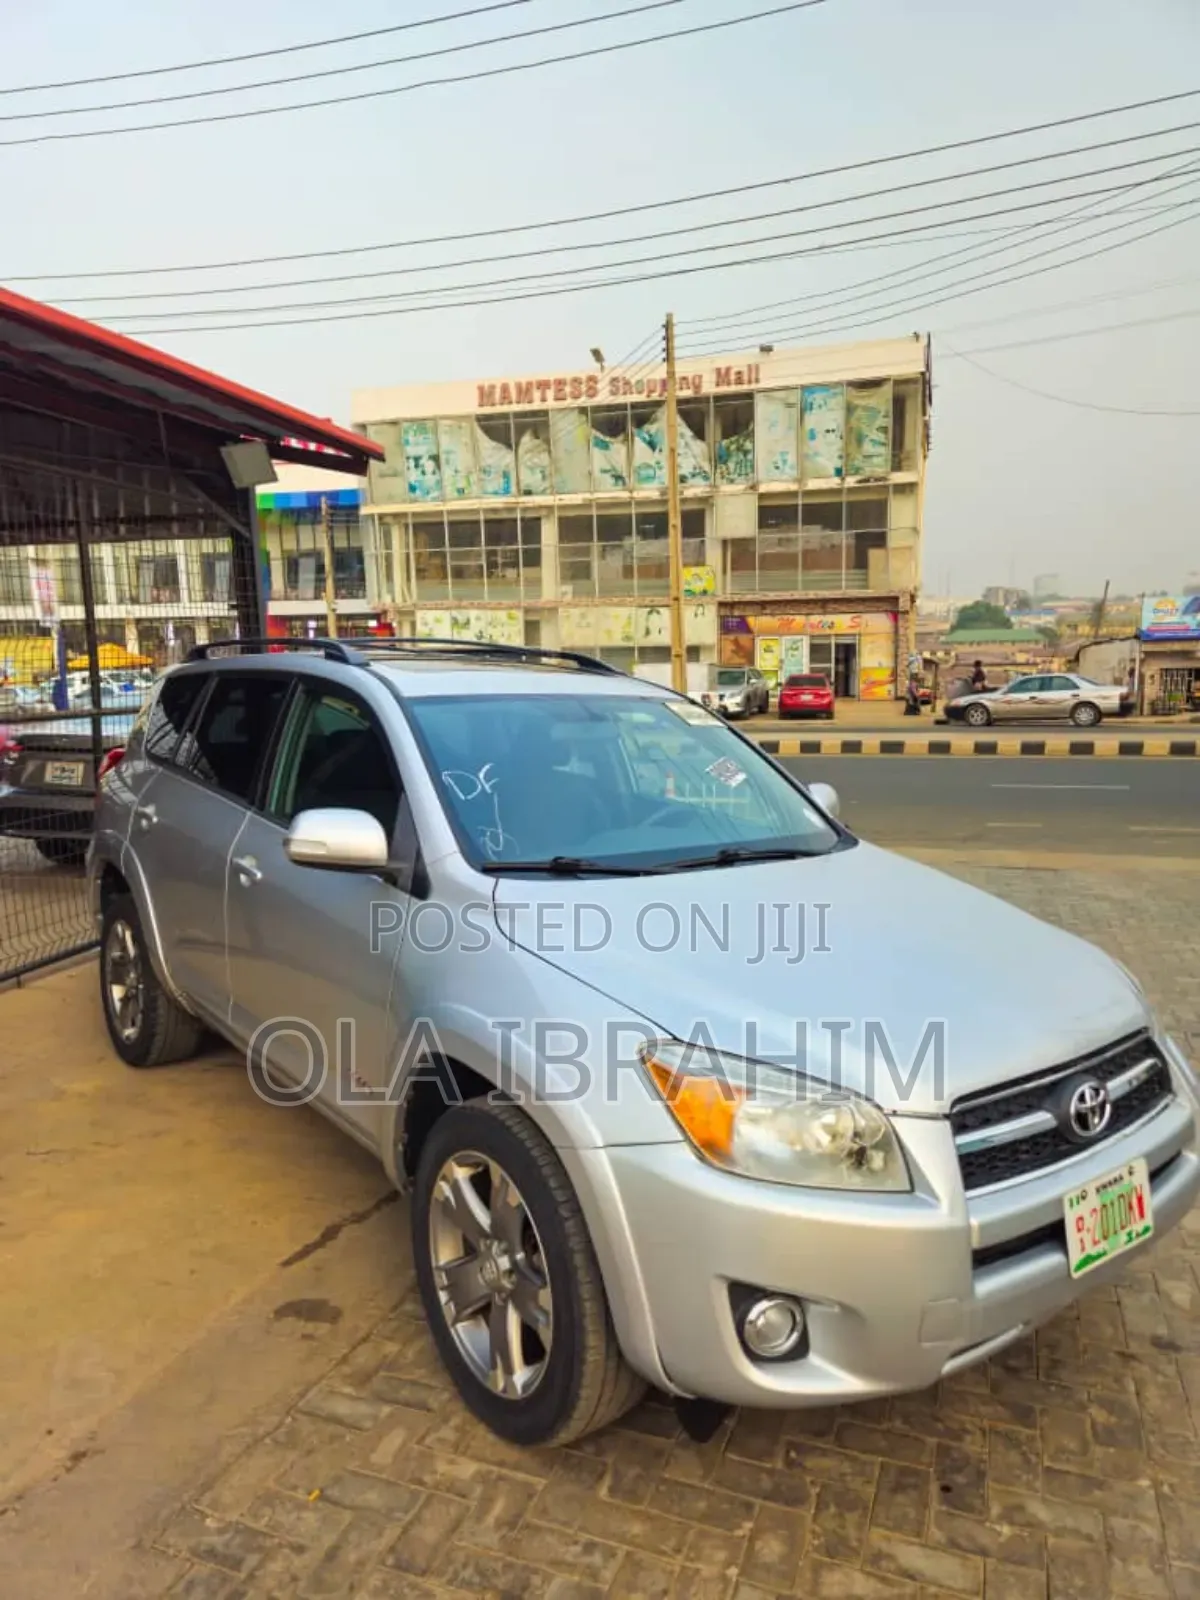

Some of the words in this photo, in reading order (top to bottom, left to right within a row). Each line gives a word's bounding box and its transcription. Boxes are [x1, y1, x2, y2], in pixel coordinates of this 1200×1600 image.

[477, 374, 600, 407] MAMTESS
[609, 372, 703, 398] Shoppng
[715, 363, 761, 387] Mall
